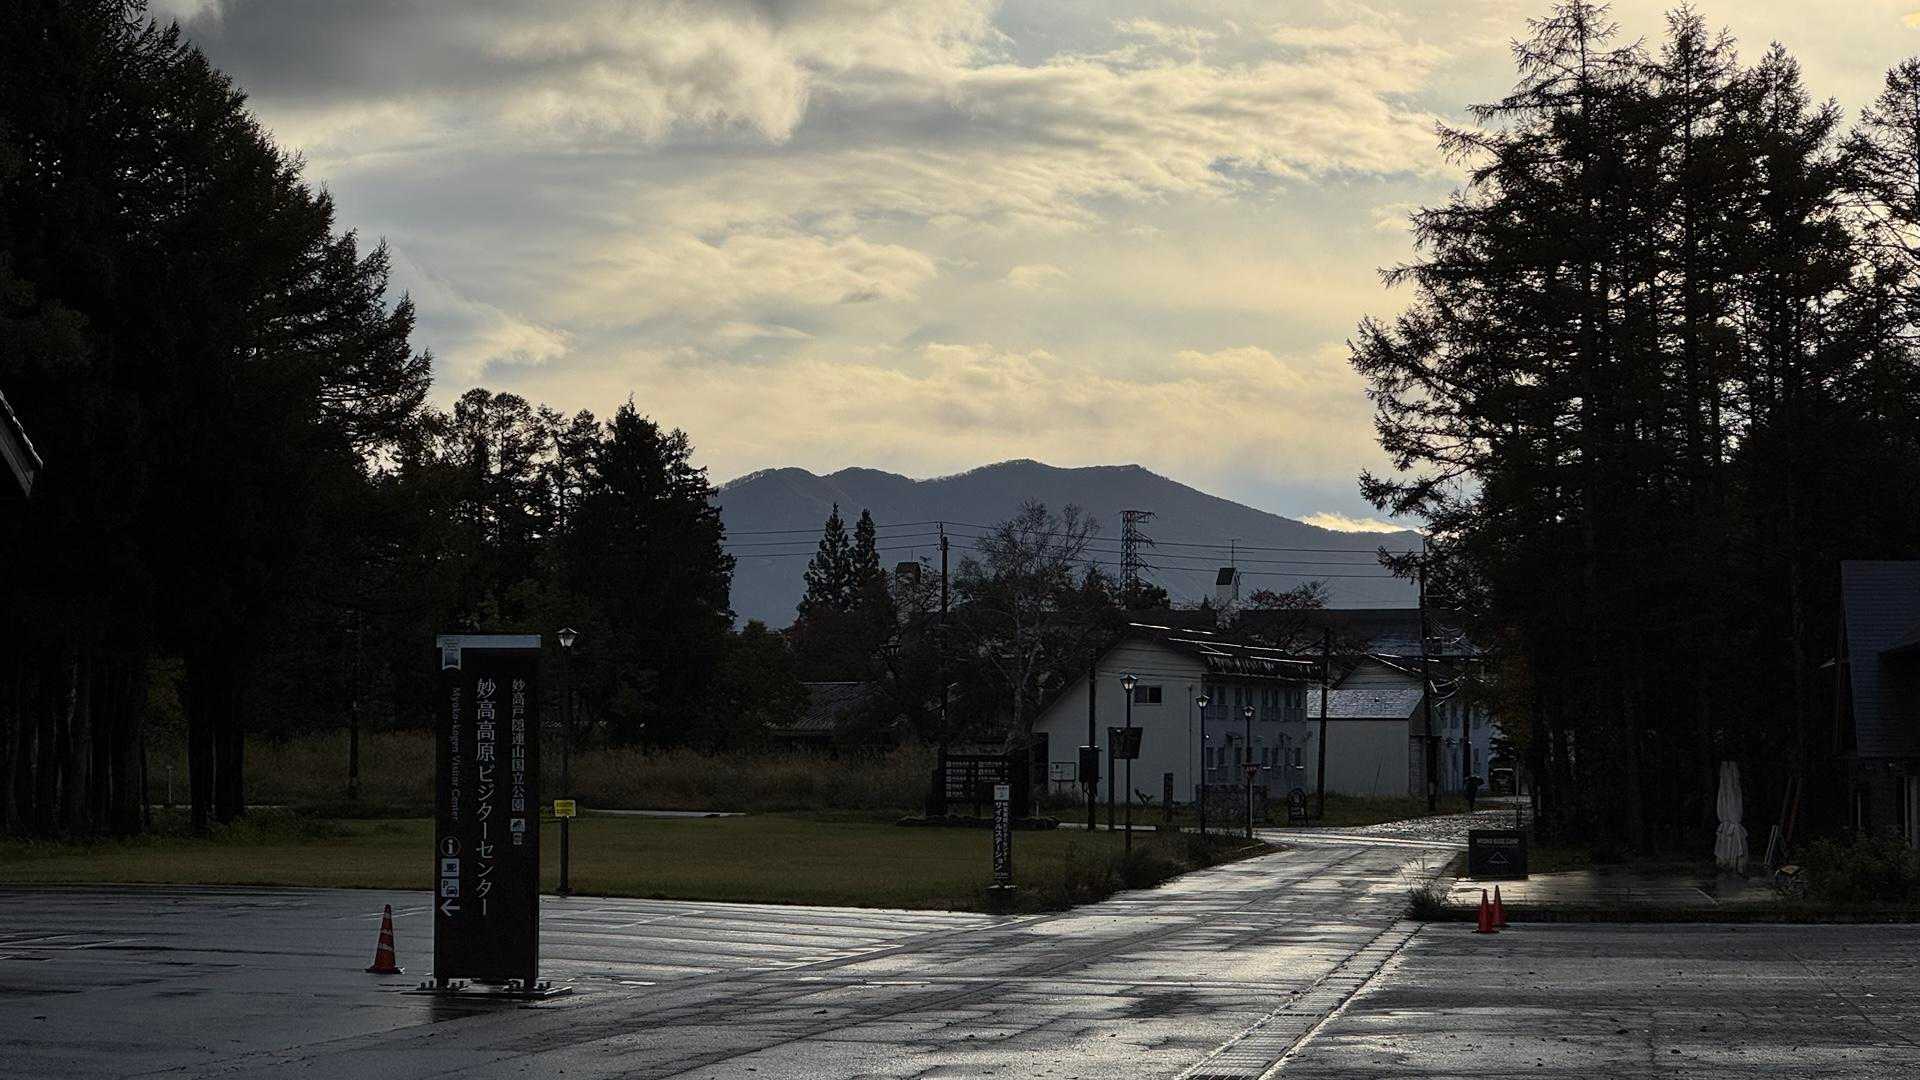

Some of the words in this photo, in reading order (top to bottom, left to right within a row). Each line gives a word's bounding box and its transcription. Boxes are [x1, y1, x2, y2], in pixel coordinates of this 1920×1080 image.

[475, 677, 497, 916] 妙高高原ビジターセンター
